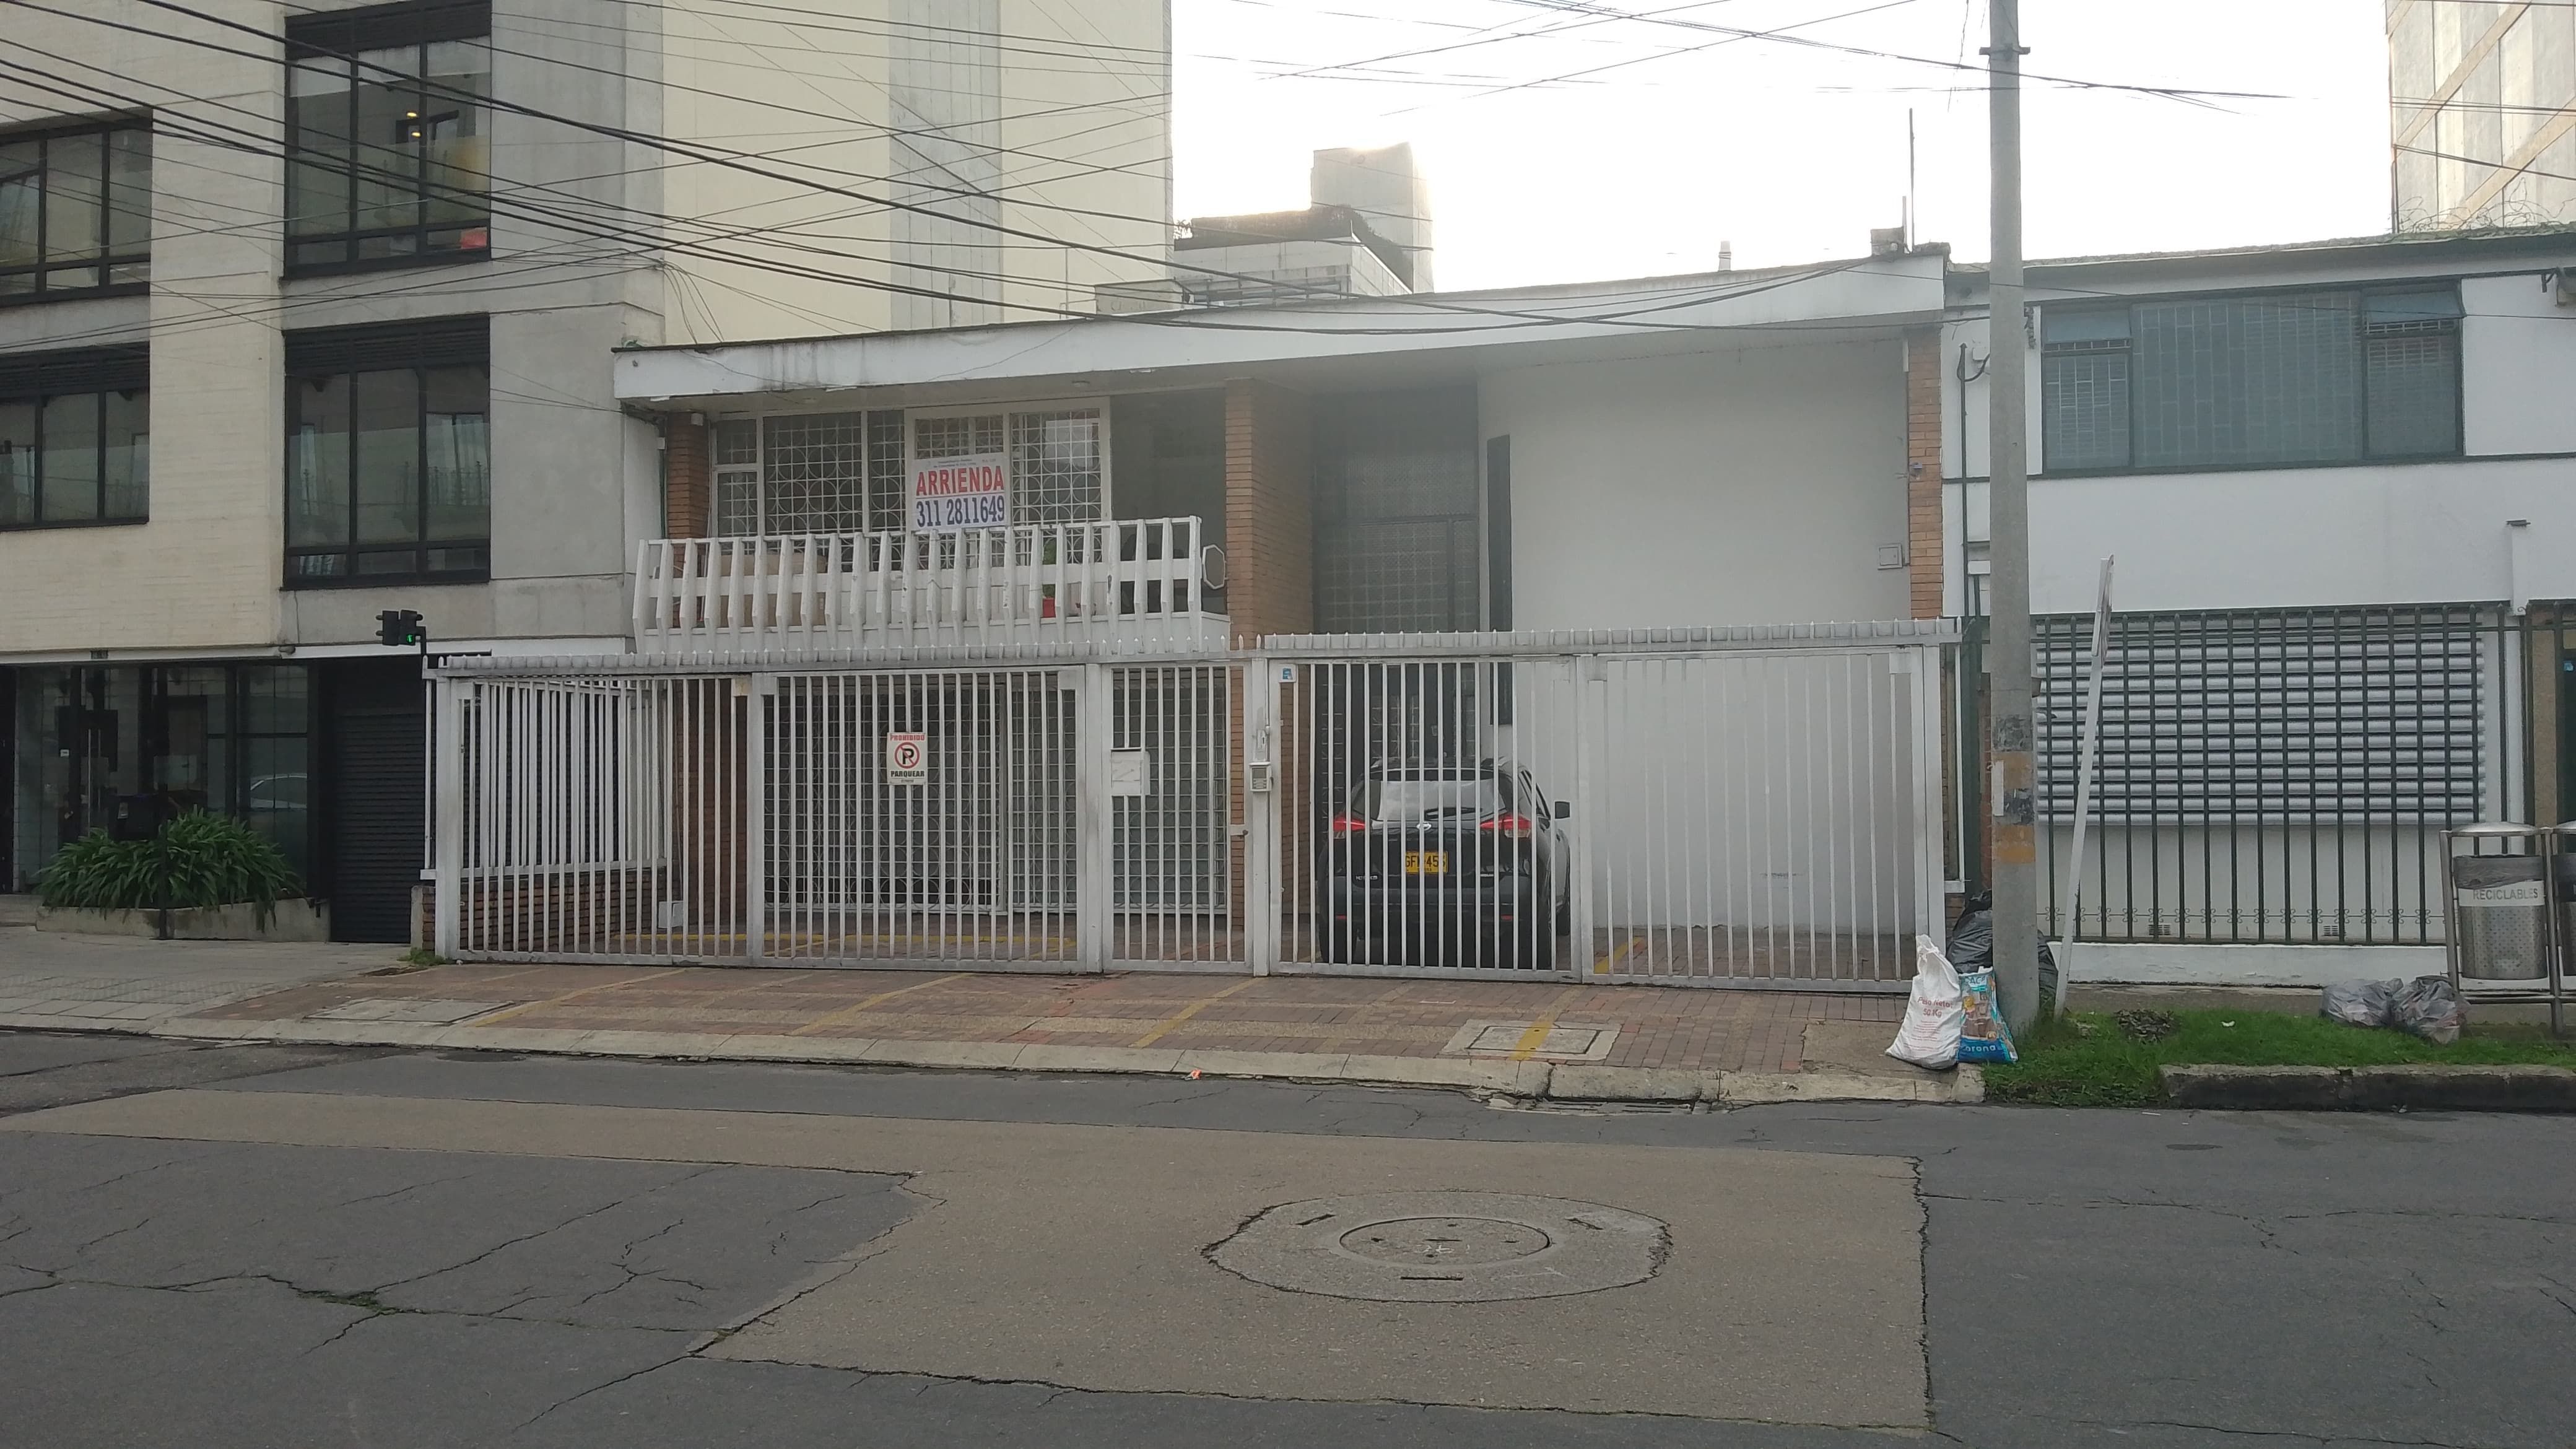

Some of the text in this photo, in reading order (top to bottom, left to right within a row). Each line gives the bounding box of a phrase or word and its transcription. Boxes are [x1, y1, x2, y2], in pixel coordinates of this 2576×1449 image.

[916, 466, 1004, 495] ARRIENDA
[916, 495, 1004, 527] 311 2811649
[2473, 888, 2538, 900] RECICLABLES
